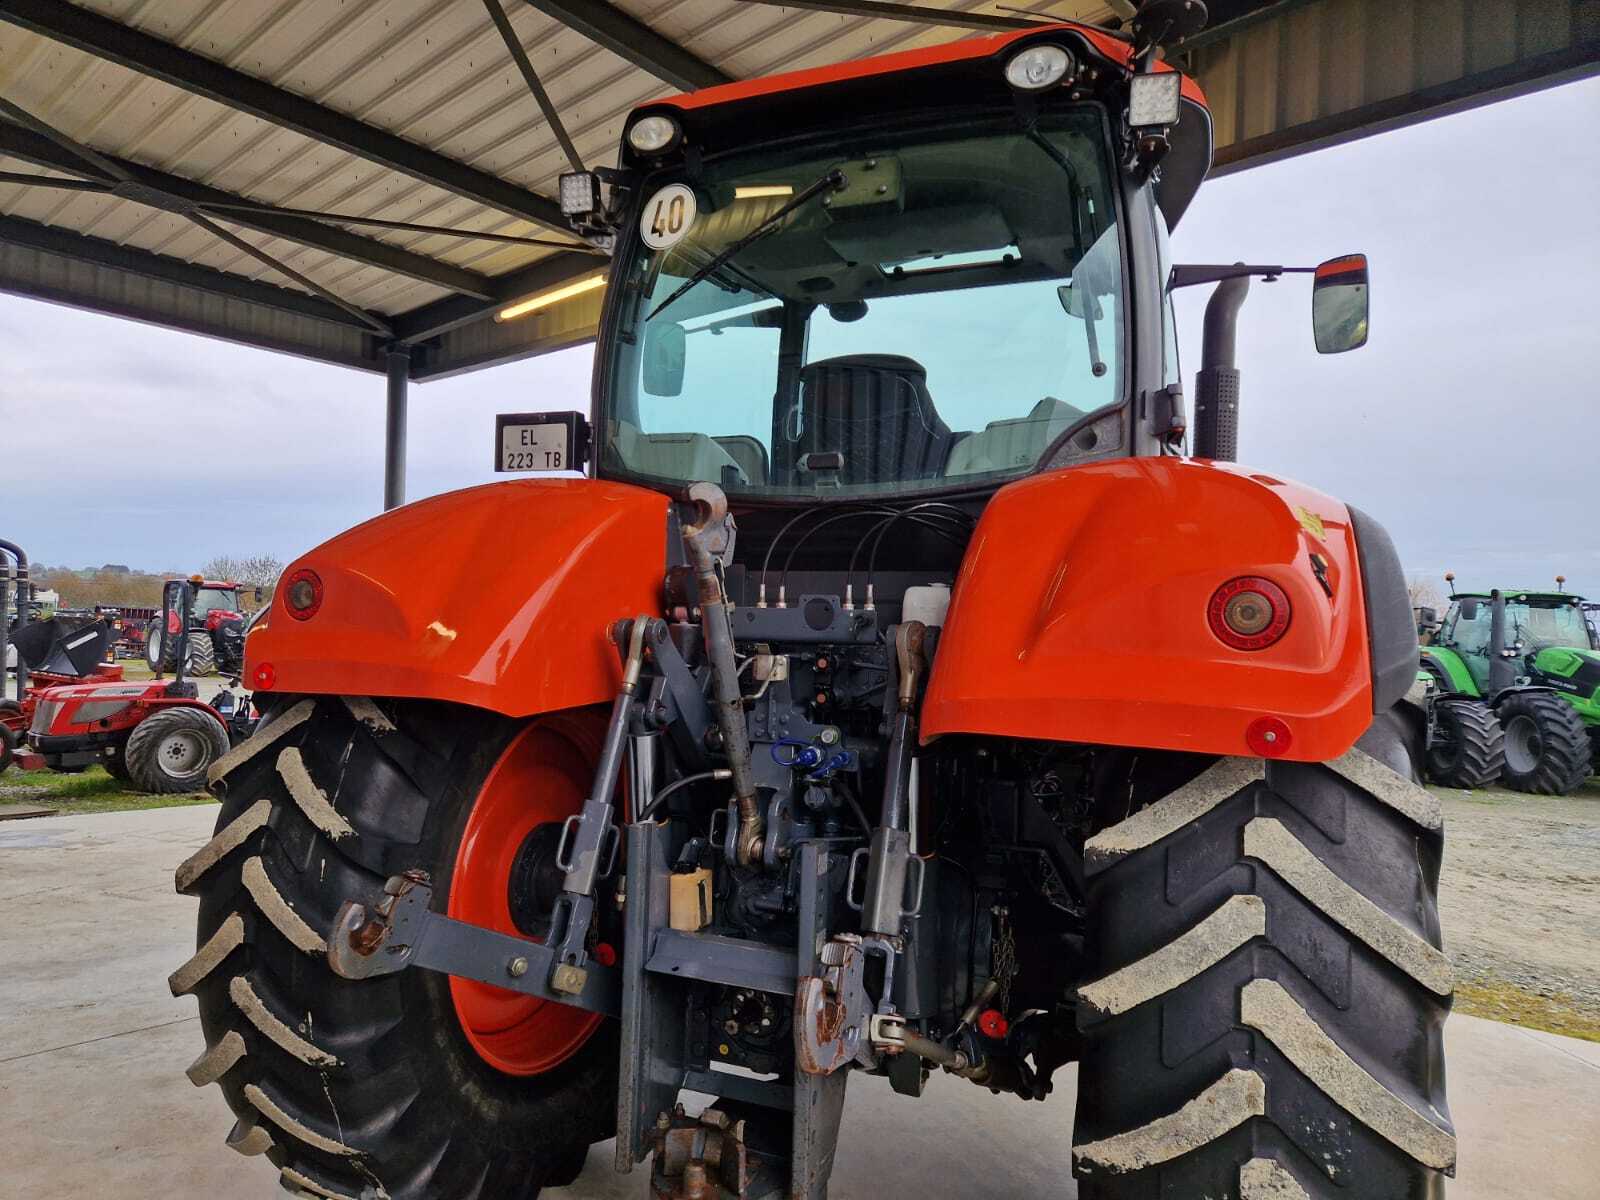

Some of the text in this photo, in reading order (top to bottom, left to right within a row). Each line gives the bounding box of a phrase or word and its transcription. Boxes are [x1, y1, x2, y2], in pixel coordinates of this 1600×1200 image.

[651, 195, 685, 238] 40
[521, 429, 538, 446] EL
[507, 451, 562, 469] 223 TB
